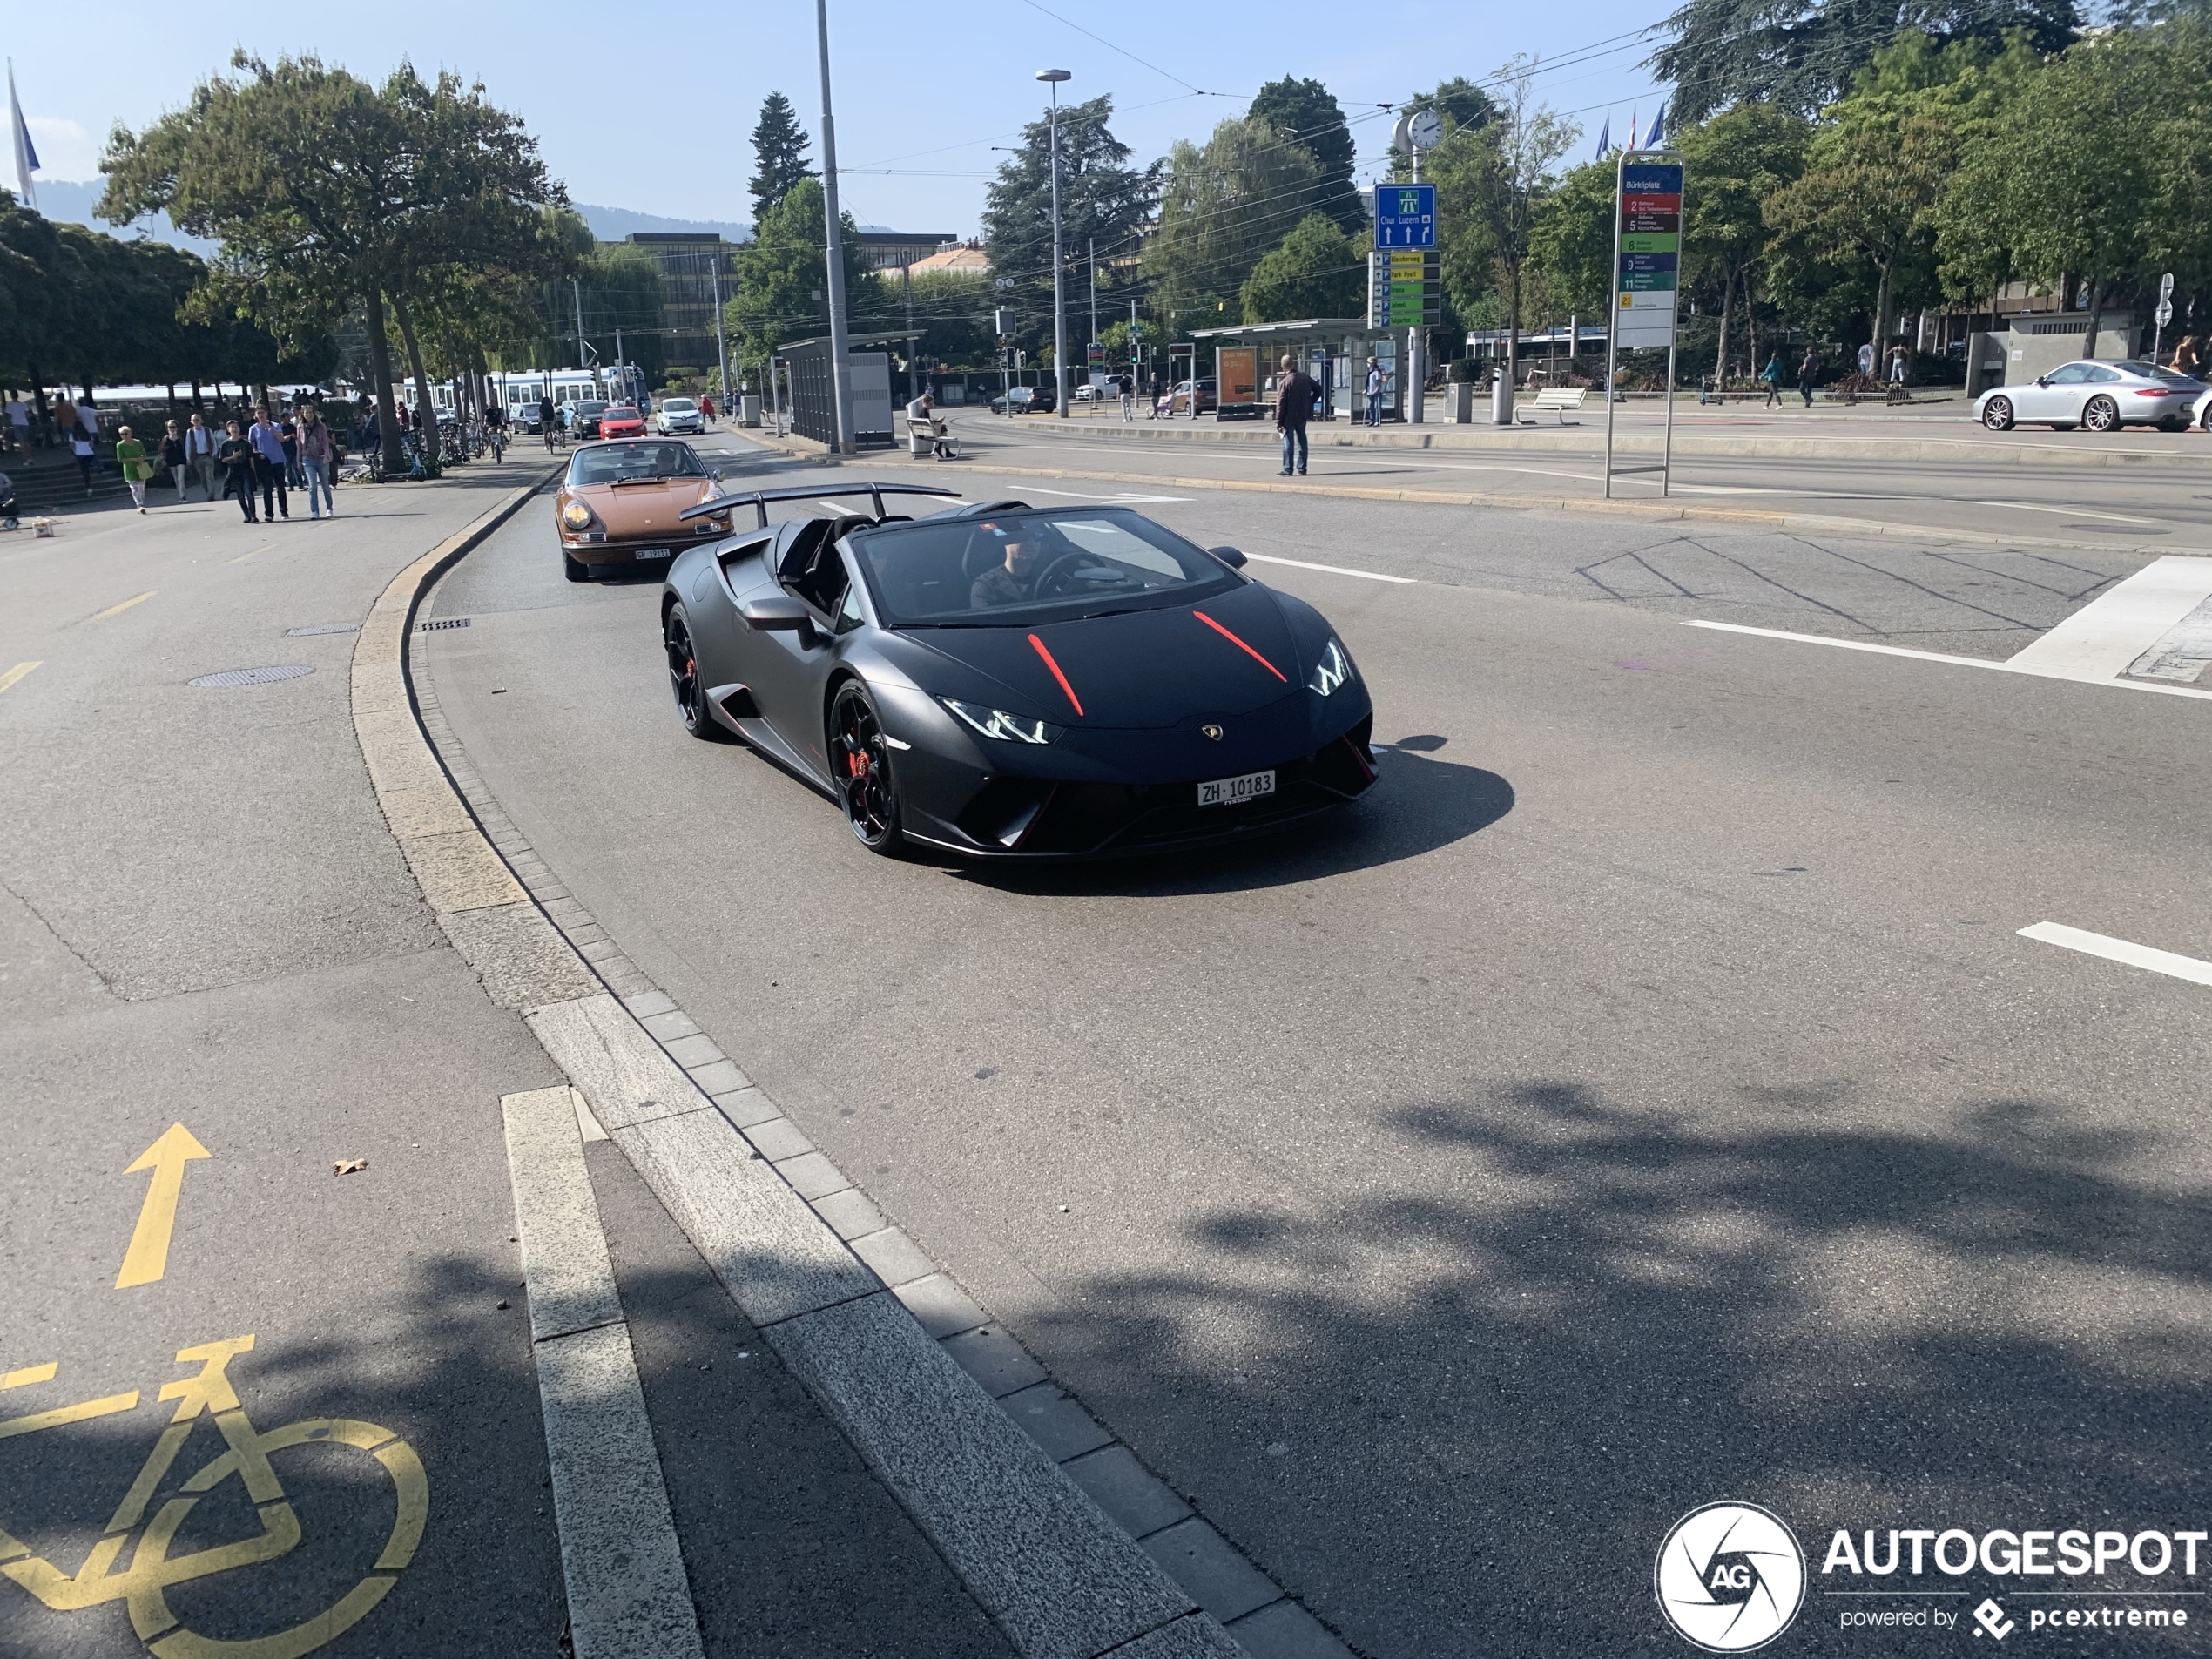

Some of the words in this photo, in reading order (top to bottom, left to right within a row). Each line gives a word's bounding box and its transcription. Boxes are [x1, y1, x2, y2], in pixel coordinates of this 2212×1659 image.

[1626, 181, 1660, 190] Bürkliplatz
[1631, 201, 1637, 212] 2
[1380, 216, 1395, 225] Chur
[1399, 216, 1420, 225] Luzern
[1629, 221, 1635, 231] 5
[1629, 241, 1635, 250] 8
[1628, 260, 1634, 270] 9
[1625, 280, 1634, 289] 11
[1203, 784, 1220, 802] ZH
[1230, 775, 1271, 798] 10183
